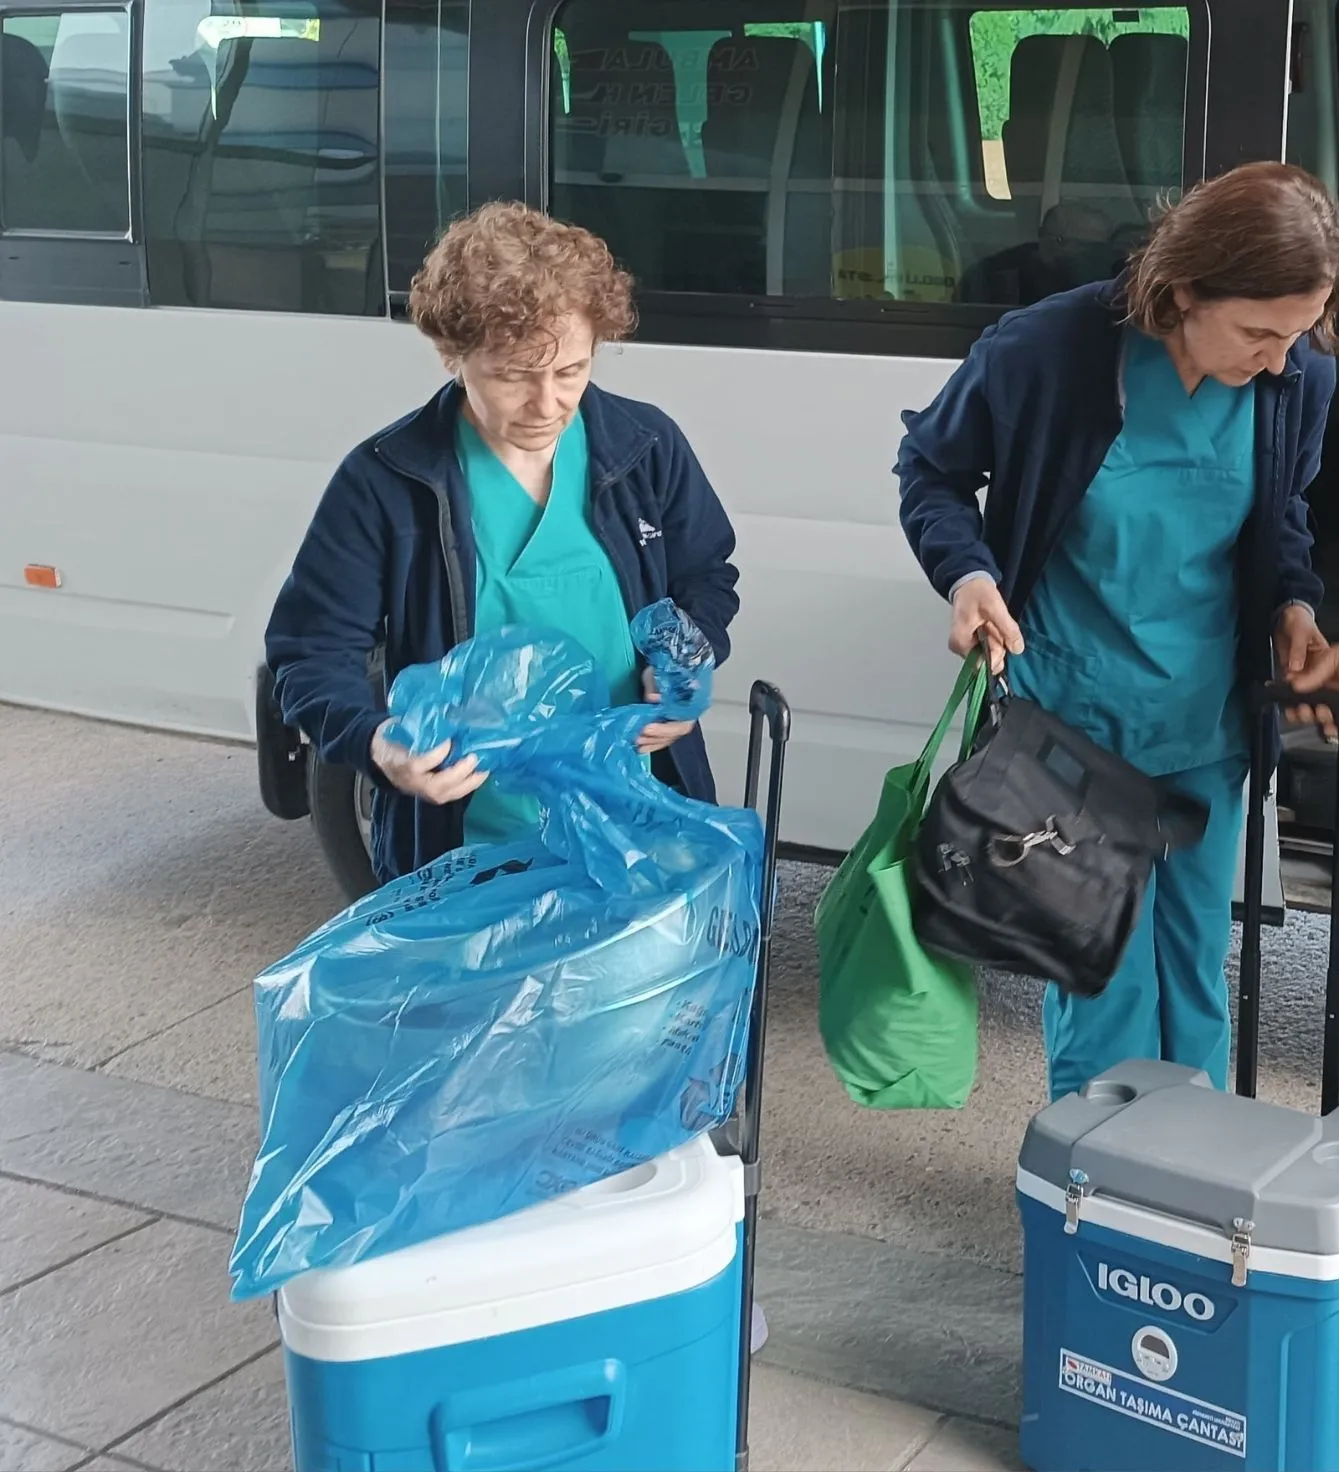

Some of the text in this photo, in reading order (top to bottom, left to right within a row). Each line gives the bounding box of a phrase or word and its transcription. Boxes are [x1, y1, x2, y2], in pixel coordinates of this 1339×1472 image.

[1098, 1262, 1215, 1321] IGLOO
[1064, 1372, 1117, 1402] ORGAN
[1119, 1391, 1173, 1424] TAŞIMA
[1176, 1412, 1244, 1449] ÇANTASI
